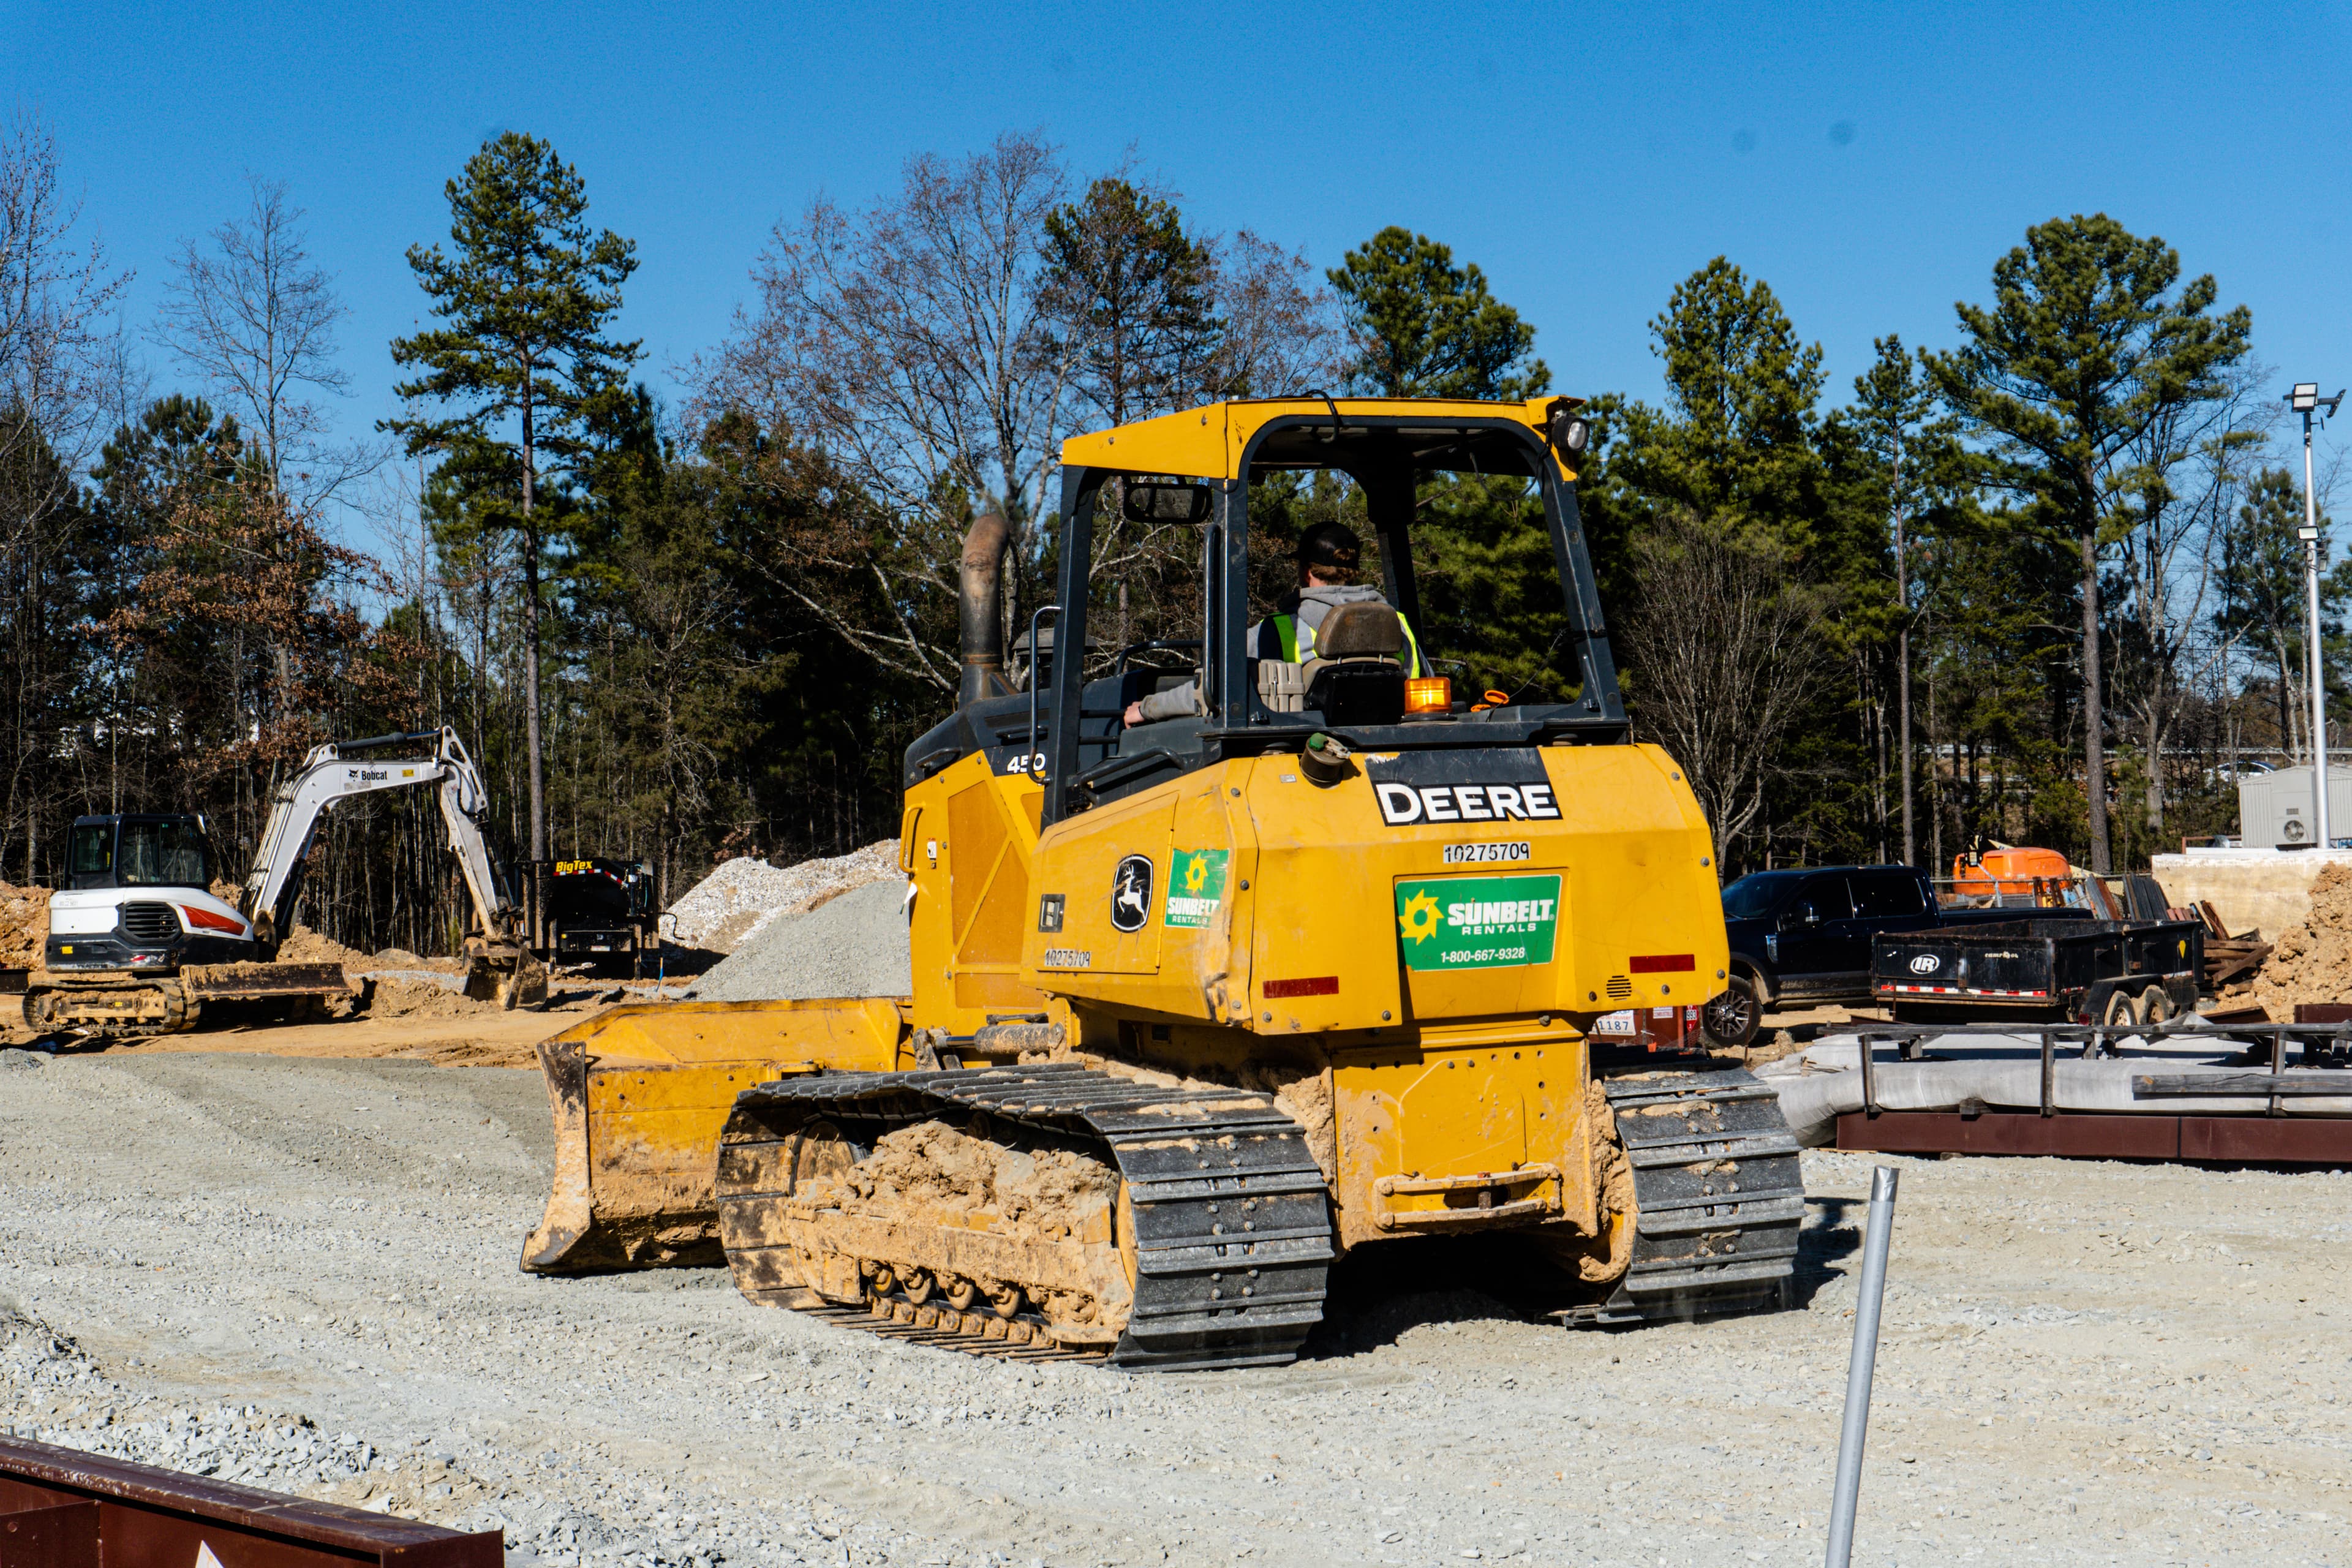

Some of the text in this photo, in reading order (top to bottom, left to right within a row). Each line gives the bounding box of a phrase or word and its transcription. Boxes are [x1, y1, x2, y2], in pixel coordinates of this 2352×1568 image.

[1006, 753, 1046, 774] 450
[361, 770, 387, 780] Bobcat
[1376, 783, 1559, 824] DEERE
[1444, 842, 1529, 863] 10275709
[1167, 896, 1220, 916] SUNBELT
[1447, 899, 1554, 926] SUNBELT
[1172, 915, 1208, 925] RENTALS
[1461, 922, 1537, 936] RENTALS
[1441, 946, 1526, 963] 1-800-667-9328
